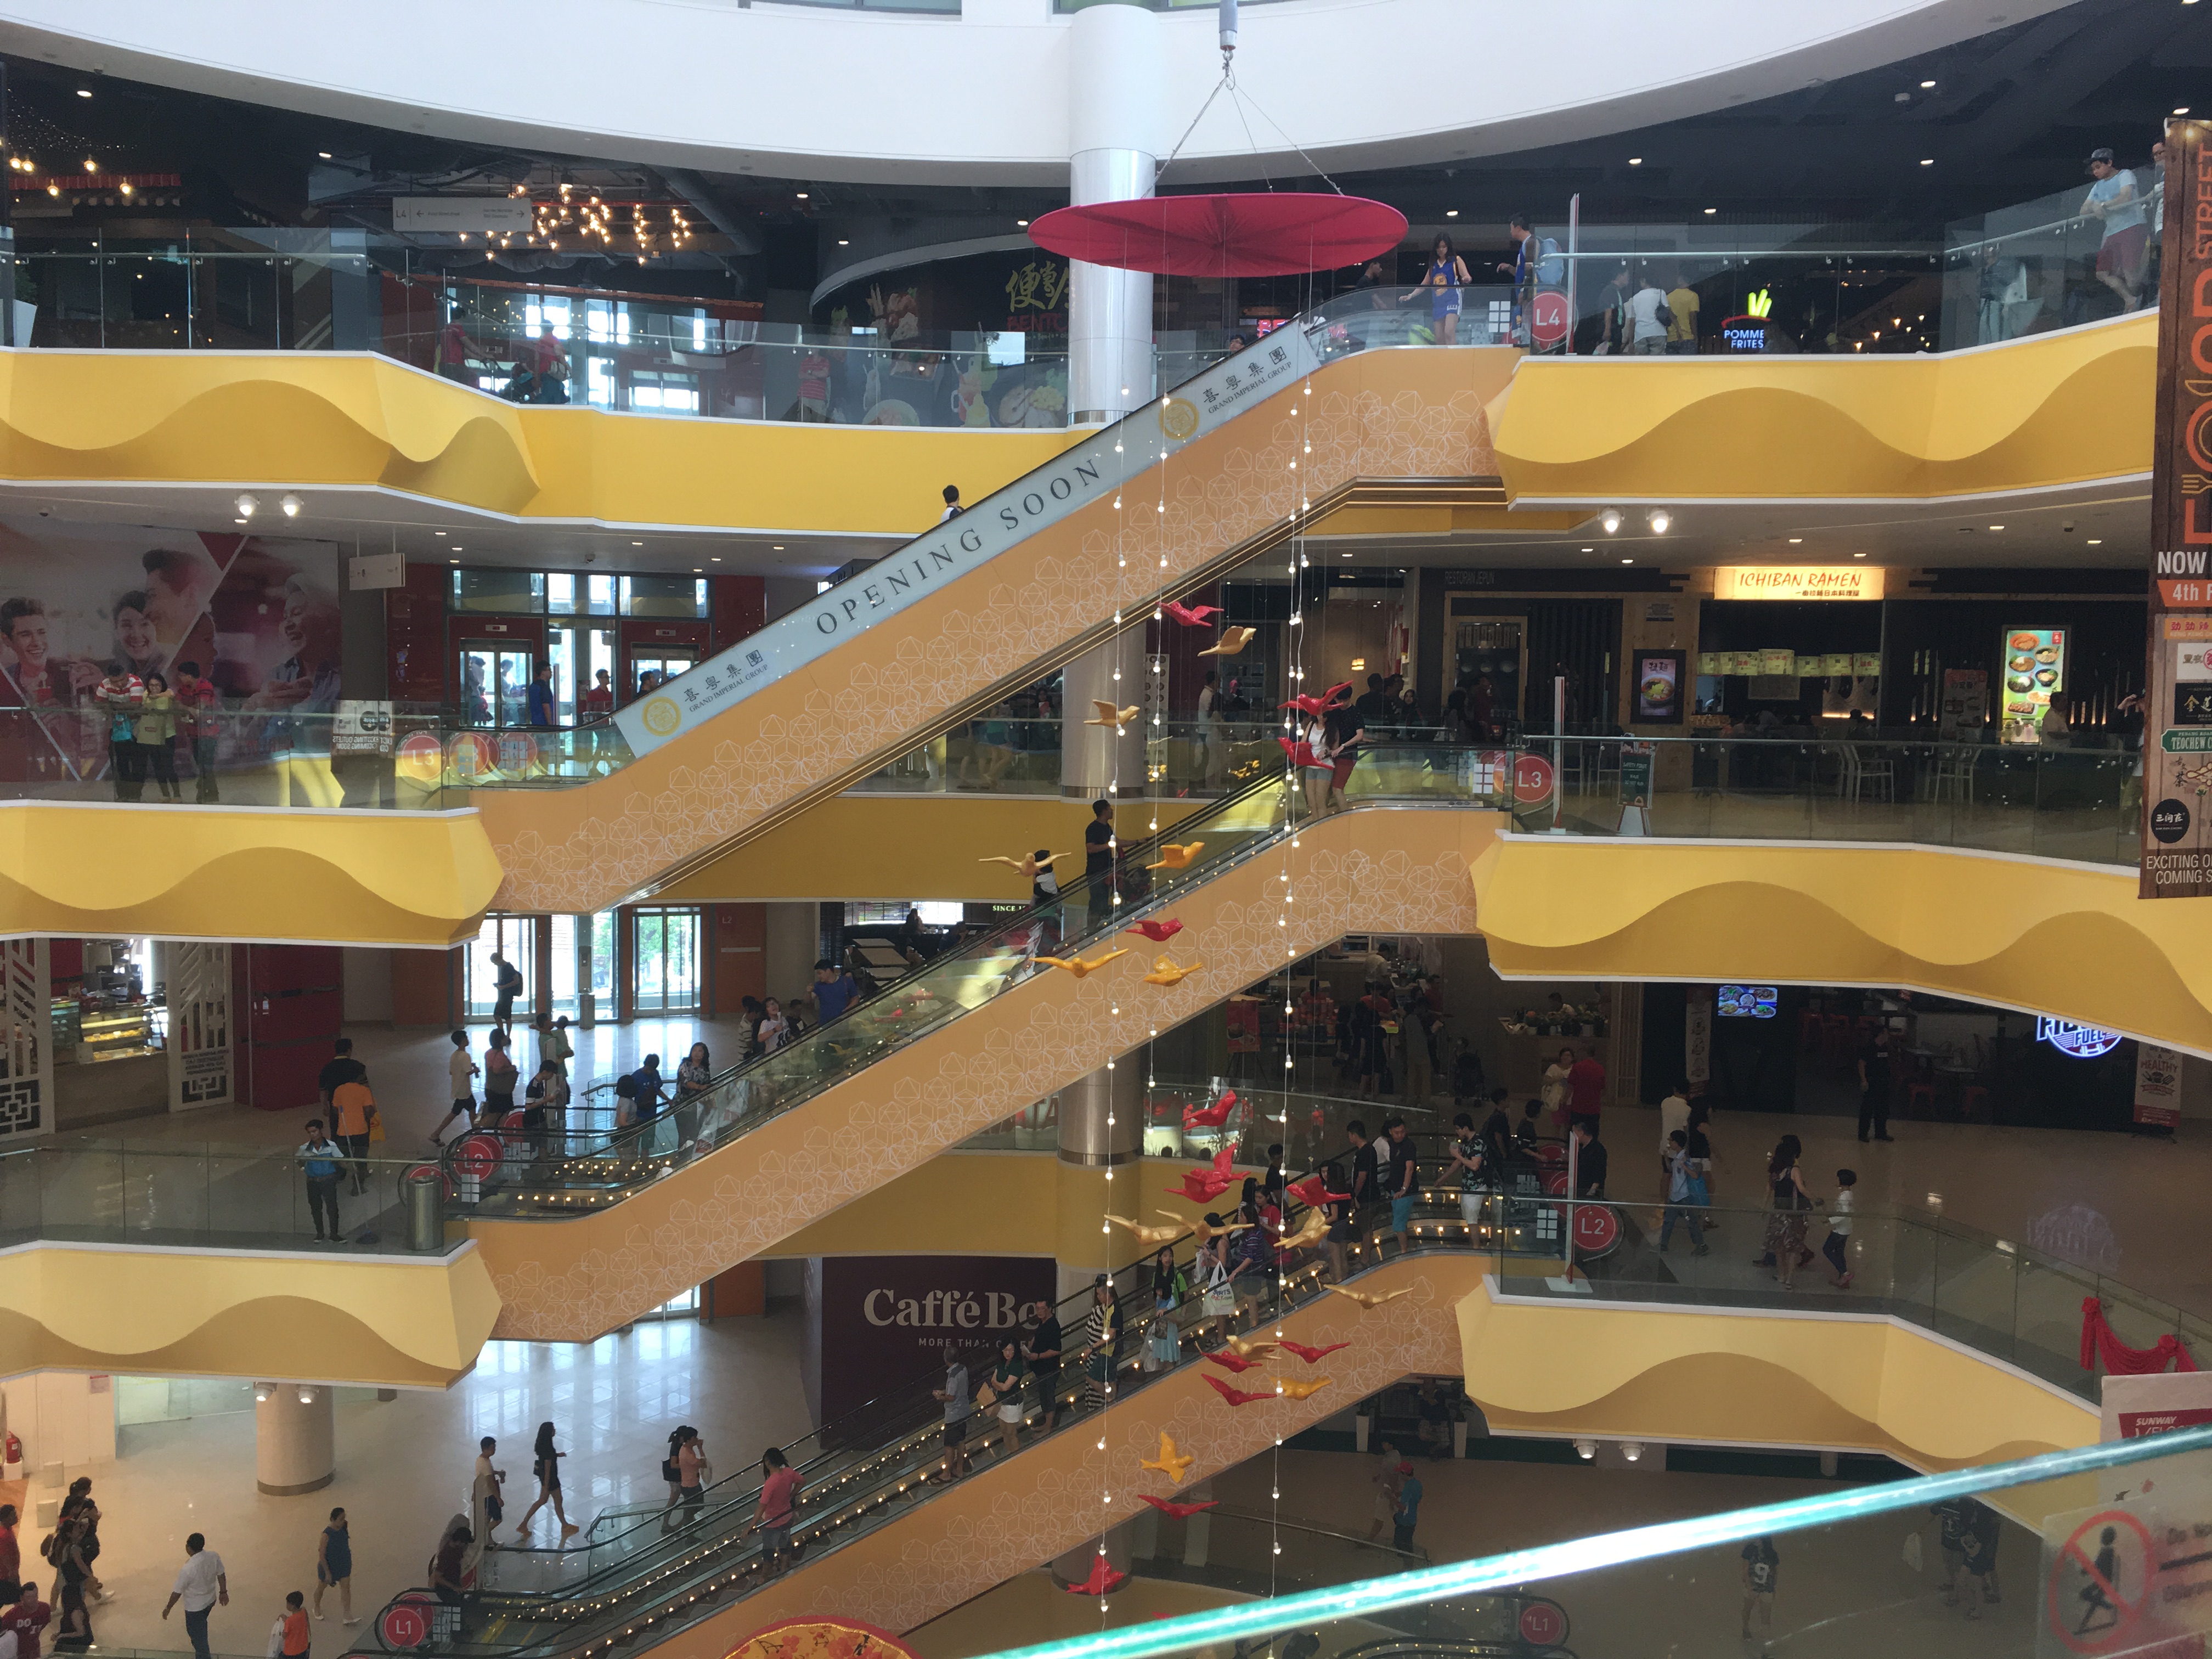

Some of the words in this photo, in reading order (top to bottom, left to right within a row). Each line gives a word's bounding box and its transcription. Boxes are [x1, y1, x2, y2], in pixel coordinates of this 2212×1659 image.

[396, 210, 407, 218] L4
[1536, 308, 1560, 326] L4
[1724, 329, 1764, 339] POMME
[1731, 339, 1764, 349] FRITES
[1208, 395, 1234, 414] GRAND
[1234, 376, 1267, 400] IMPERIAL
[1268, 361, 1292, 379] GROUP
[816, 528, 983, 635] OPENING
[1000, 459, 1101, 531] SOON
[2158, 551, 2207, 574] NOW
[1740, 572, 1803, 587] ICHIBAN
[1808, 572, 1862, 587] RAMEN
[2172, 583, 2199, 601] 4th
[689, 696, 713, 712] GRAND
[713, 678, 745, 699] IMPERIAL
[745, 664, 768, 680] GROUP
[2171, 737, 2206, 750] TEOCHEW
[413, 749, 435, 766] L3
[1518, 770, 1542, 788] L3
[2146, 854, 2199, 870] EXCITING
[2155, 870, 2202, 884] COMING
[2074, 1030, 2105, 1047] FUEL
[2141, 1059, 2178, 1073] HEALTHY
[465, 1154, 484, 1168] L2
[1581, 1217, 1605, 1234] L2
[864, 1289, 980, 1328] Caffé
[919, 1338, 952, 1347] MORE
[957, 1339, 989, 1348] THAN
[2136, 1416, 2177, 1426] SUNWAY
[1755, 1562, 1769, 1584] 9
[16, 1618, 32, 1628] DO
[396, 1620, 411, 1635] L1
[1532, 1616, 1548, 1631] L1
